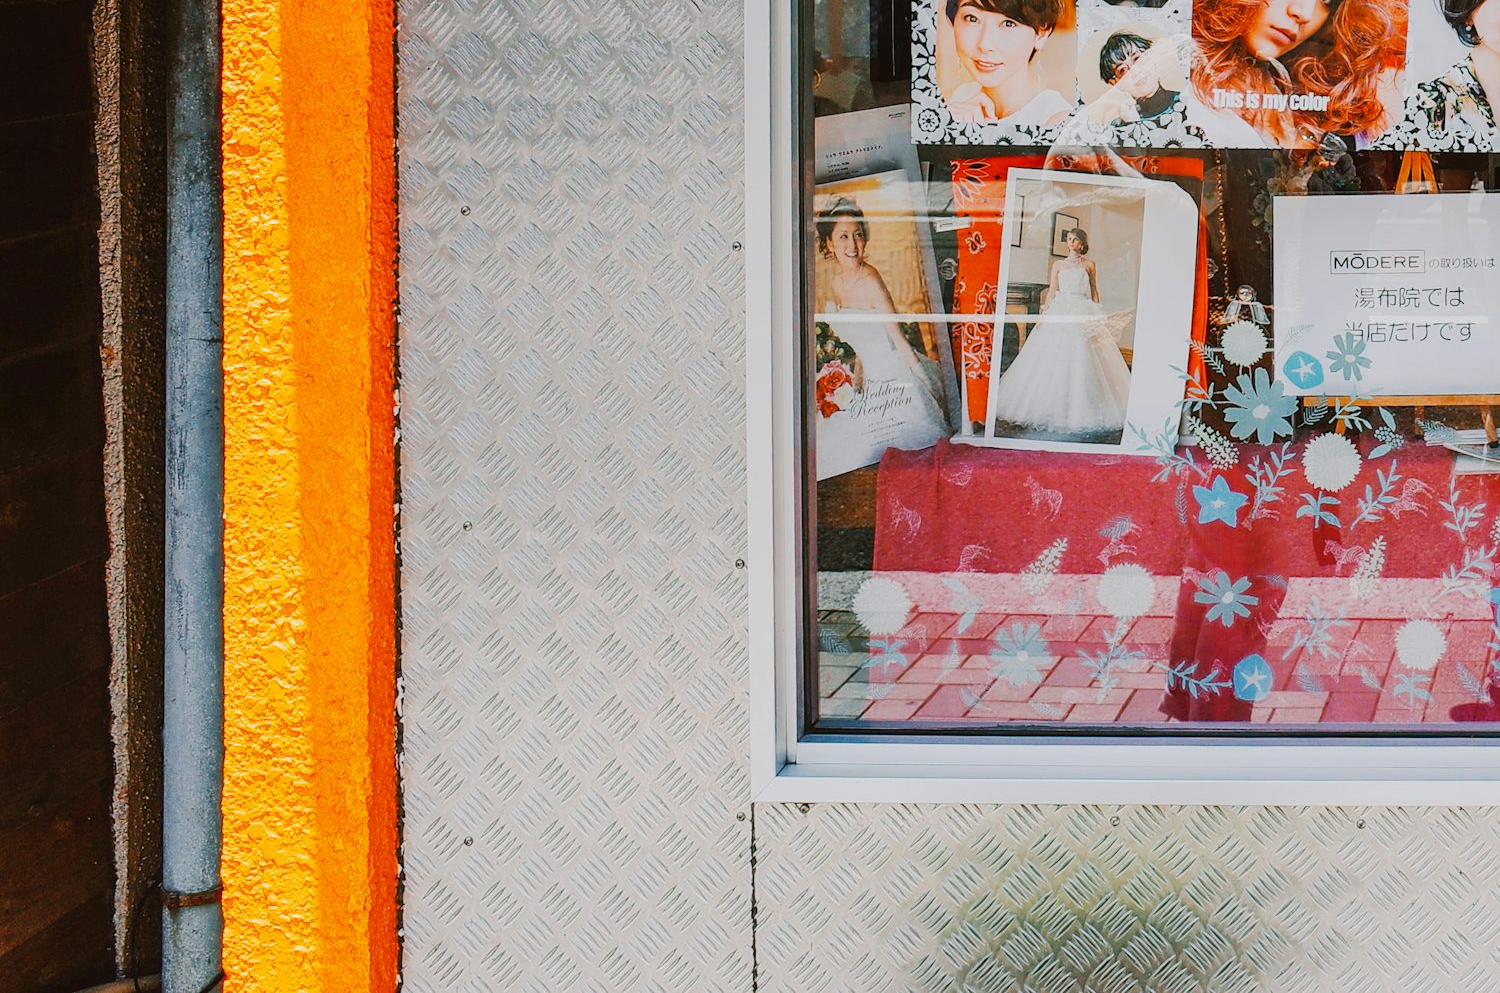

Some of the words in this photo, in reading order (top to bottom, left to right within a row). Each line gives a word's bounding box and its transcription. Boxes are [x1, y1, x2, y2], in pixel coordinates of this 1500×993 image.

[1211, 87, 1244, 109] This
[1245, 89, 1260, 109] is
[1262, 93, 1289, 113] my
[1289, 91, 1331, 113] color
[1428, 256, 1496, 270] の取り扱いは
[1353, 286, 1466, 310] 湯布院では
[1344, 321, 1477, 343] 当店だけです
[849, 383, 905, 404] Wedding
[850, 396, 912, 419] Reception
